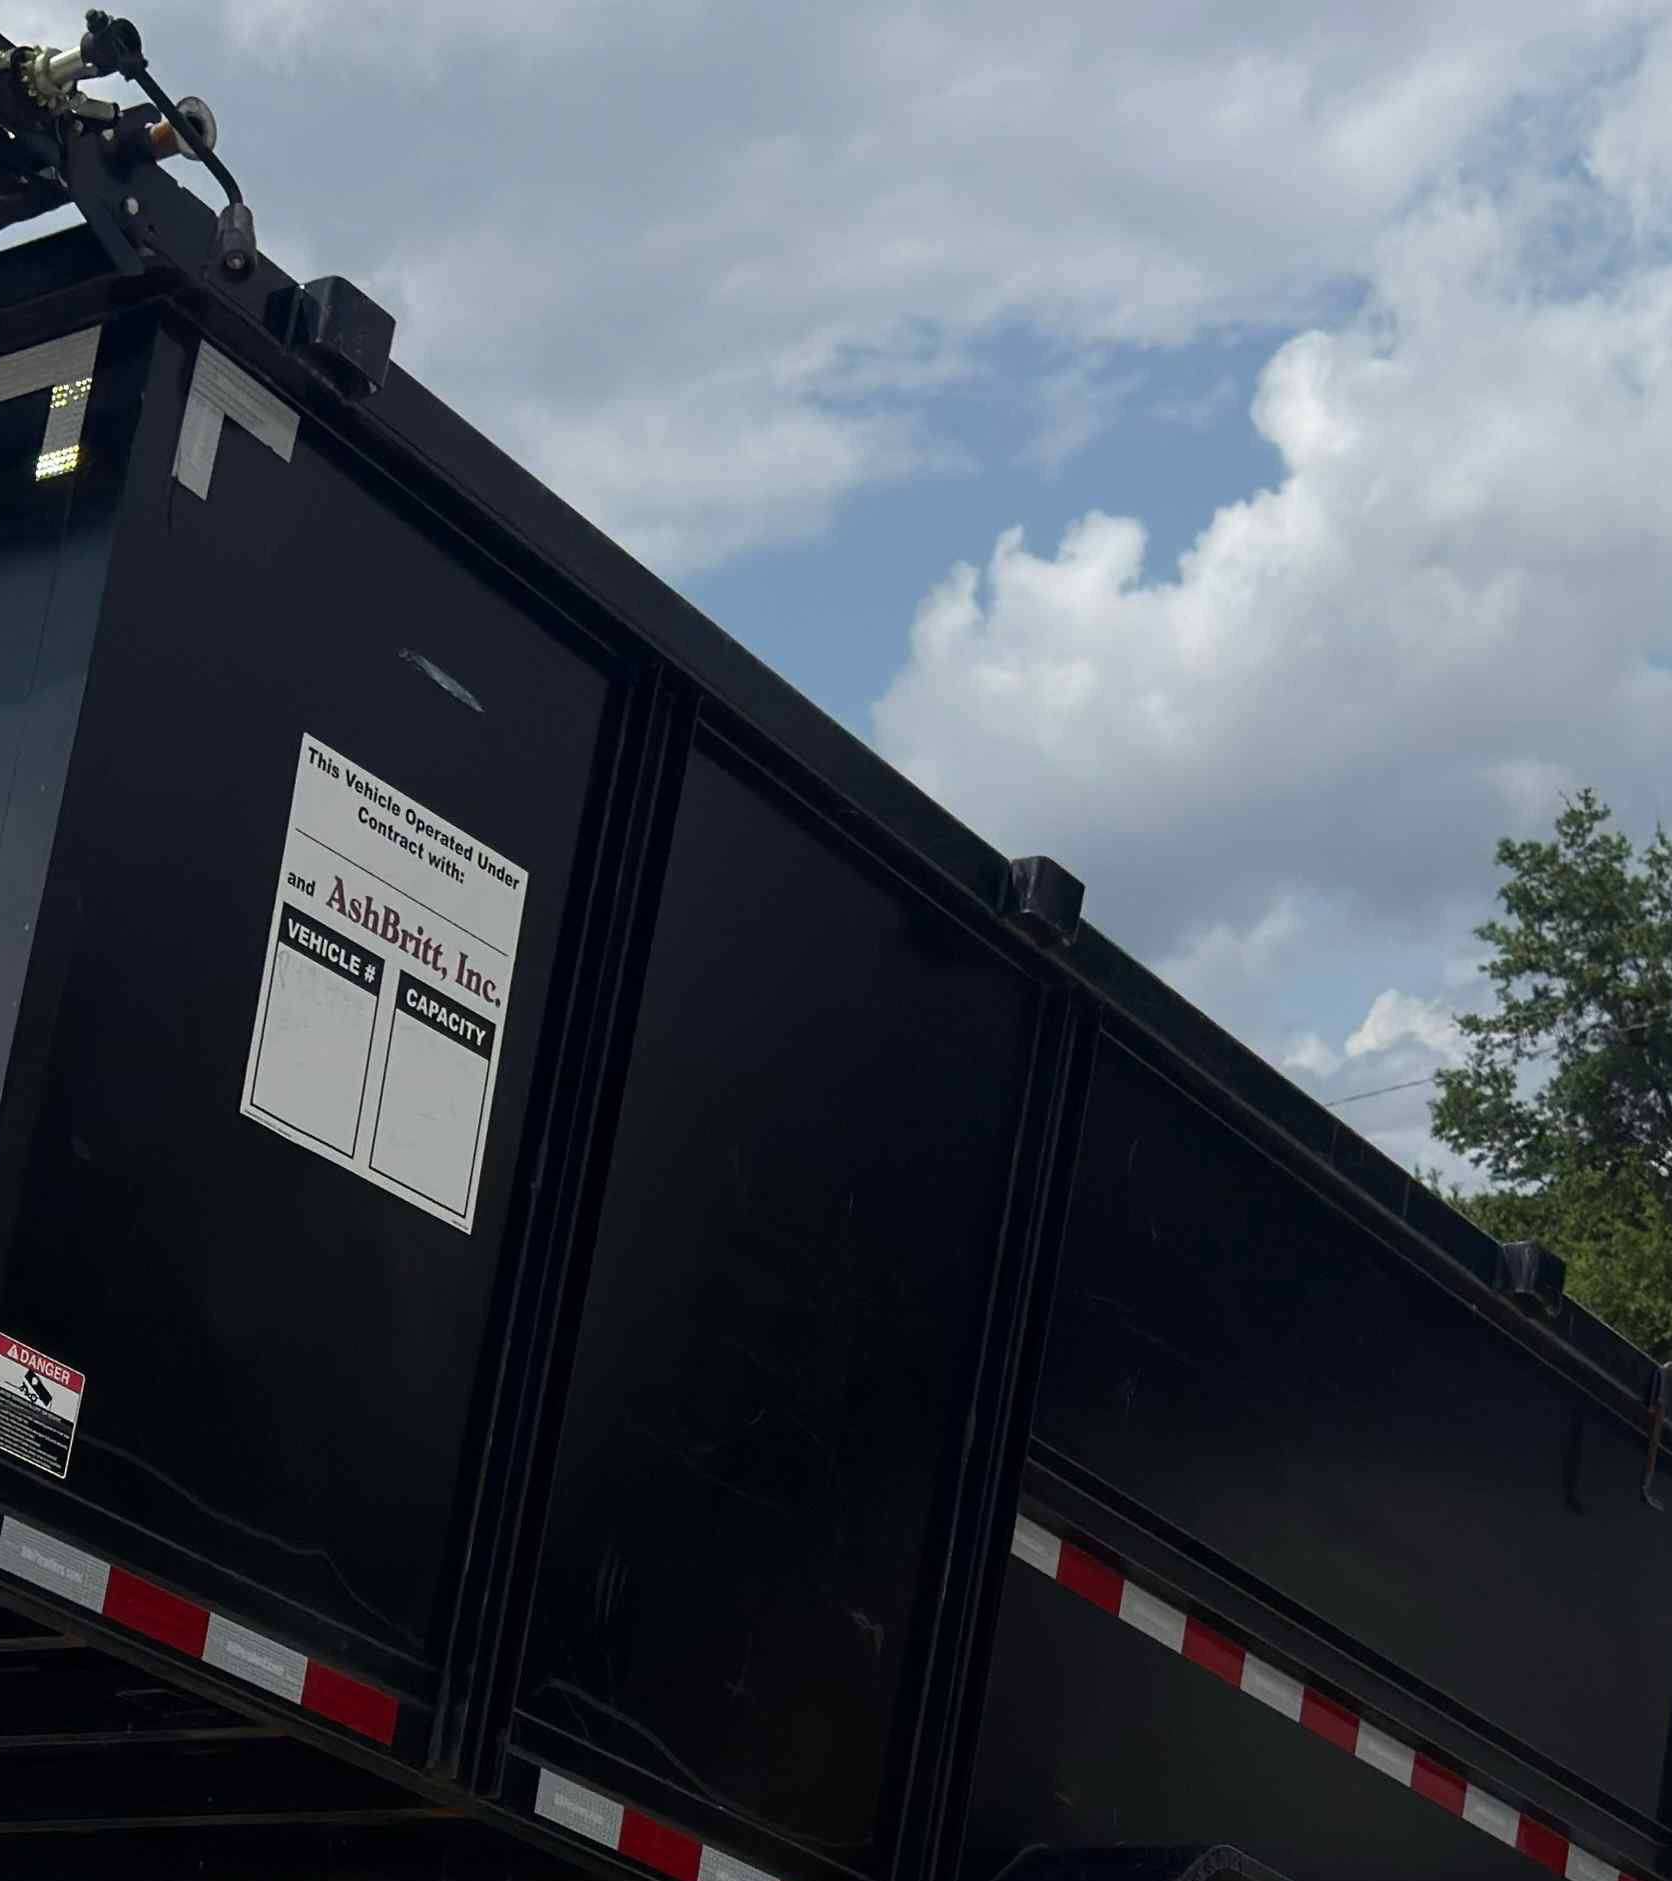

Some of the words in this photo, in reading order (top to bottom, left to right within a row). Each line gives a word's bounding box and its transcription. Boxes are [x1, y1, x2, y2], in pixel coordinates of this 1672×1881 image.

[307, 745, 341, 780] This
[344, 768, 402, 816] Vehicle
[405, 808, 474, 862] Operated
[477, 851, 520, 891] Under
[357, 805, 424, 861] Contract
[427, 850, 466, 885] with:
[286, 870, 316, 897] and
[325, 875, 448, 981] AshBritt,
[454, 950, 502, 1009] Inc.
[287, 917, 362, 977] VEHICLE
[363, 962, 377, 984] #
[405, 987, 487, 1047] CAPACITY
[19, 1348, 71, 1386] DANGER
